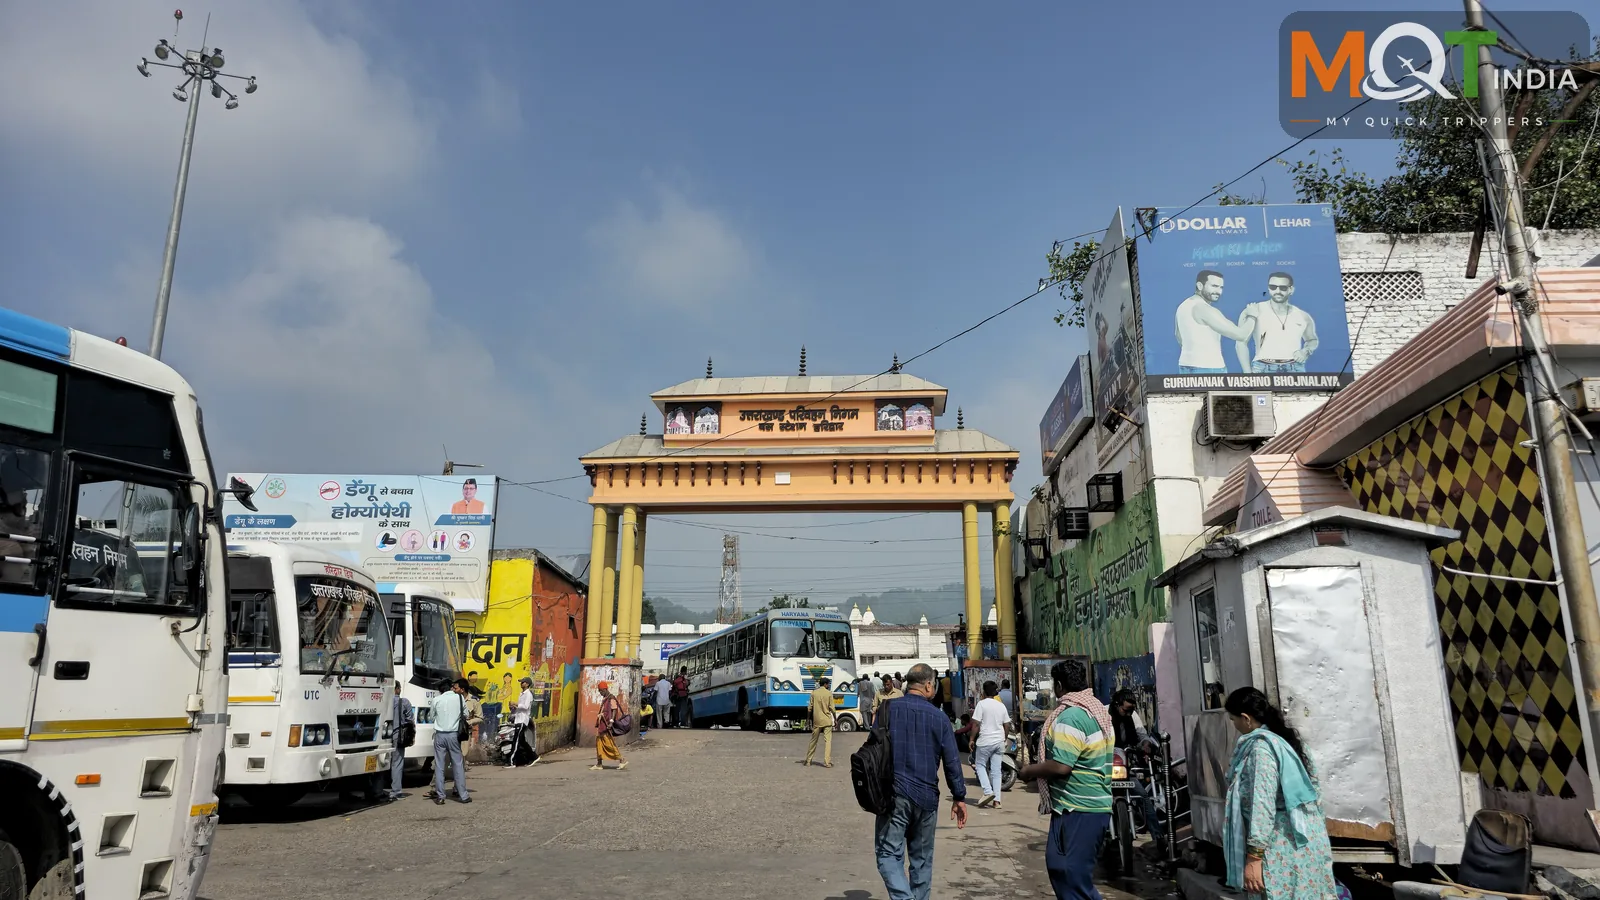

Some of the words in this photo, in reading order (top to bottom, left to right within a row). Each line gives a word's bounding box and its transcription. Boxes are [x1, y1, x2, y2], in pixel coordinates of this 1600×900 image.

[1177, 217, 1248, 231] DOLLAR
[1273, 218, 1312, 228] LEHAR
[1163, 376, 1225, 389] GURUNANAK
[1227, 376, 1271, 388] VAISHNO
[1273, 375, 1341, 387] BHOJNALAYA
[788, 405, 827, 421] परिवहन
[829, 404, 859, 420] निगम
[758, 421, 775, 432] बस
[779, 420, 807, 432] स्टेशन
[345, 479, 378, 501] डेंगू
[380, 486, 388, 495] से
[331, 501, 412, 519] होम्योपैथी
[1252, 506, 1275, 528] TOILE
[378, 519, 388, 528] के
[391, 520, 411, 528] साथ
[814, 612, 842, 620] ROADWAYS
[304, 690, 320, 700] UTC
